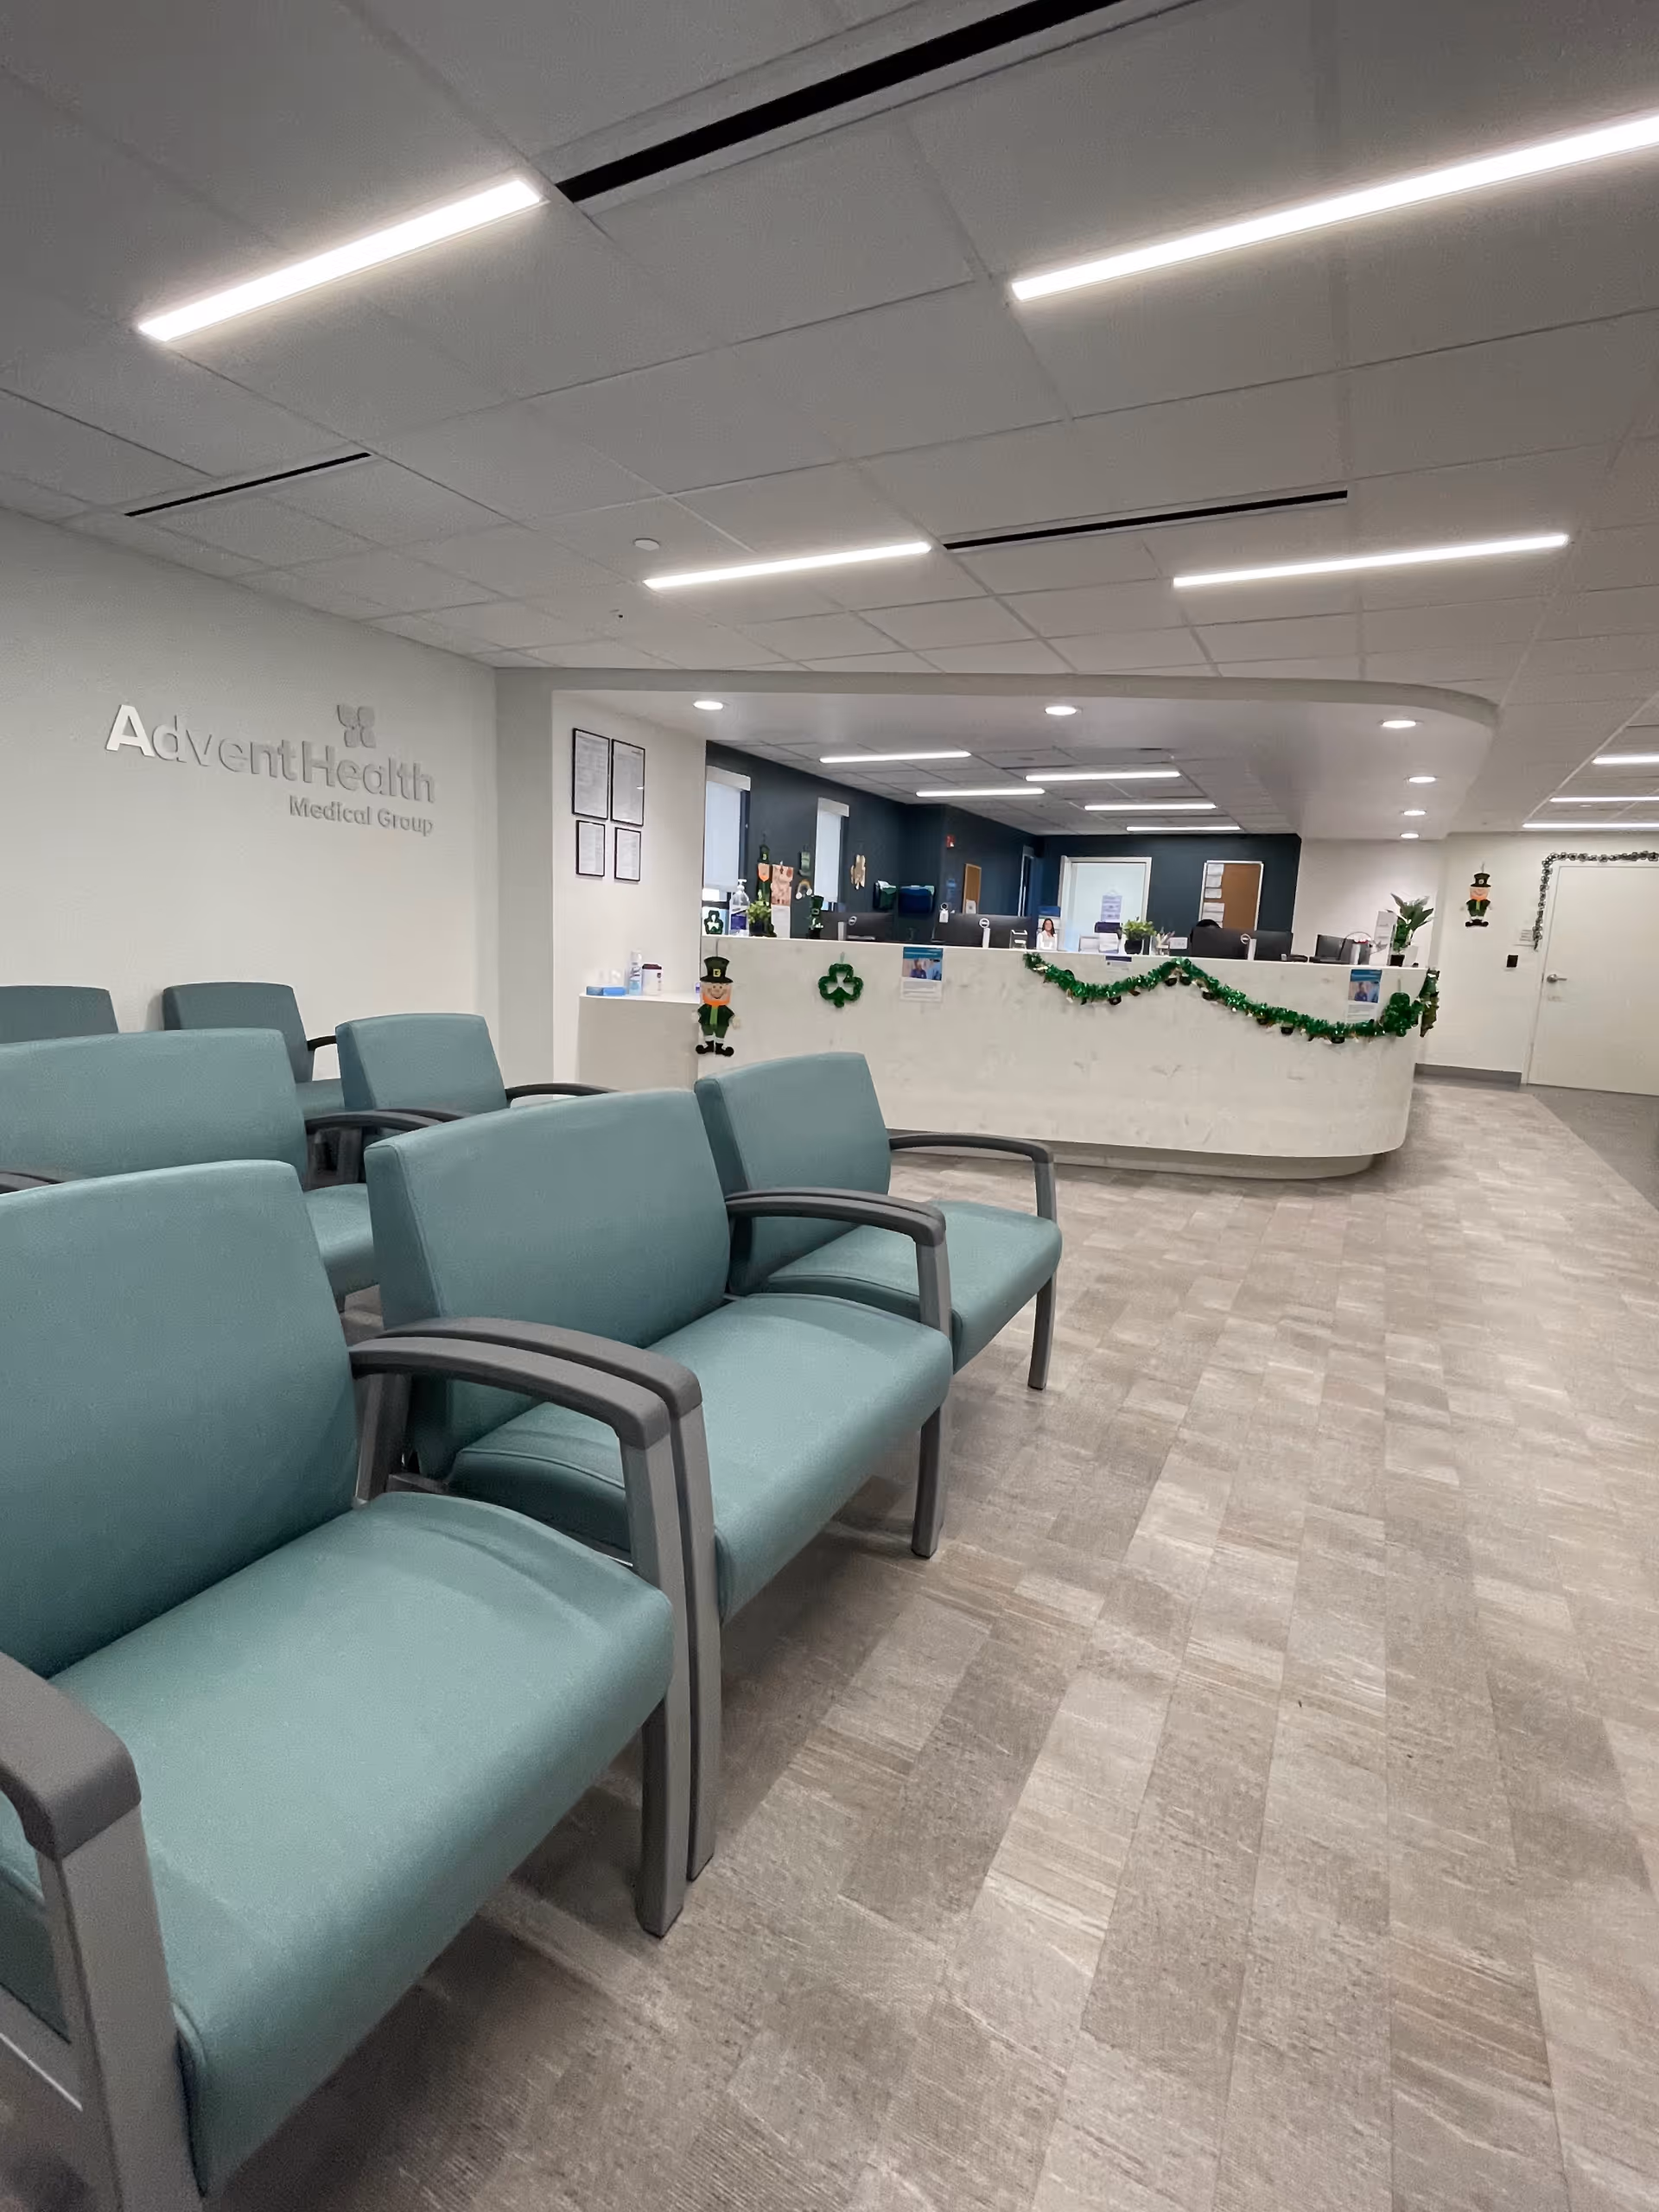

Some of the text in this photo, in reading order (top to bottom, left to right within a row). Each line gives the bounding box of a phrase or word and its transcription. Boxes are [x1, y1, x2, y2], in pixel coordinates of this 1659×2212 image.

[105, 704, 435, 804] AdventHealth
[289, 795, 434, 836] Medical Group
